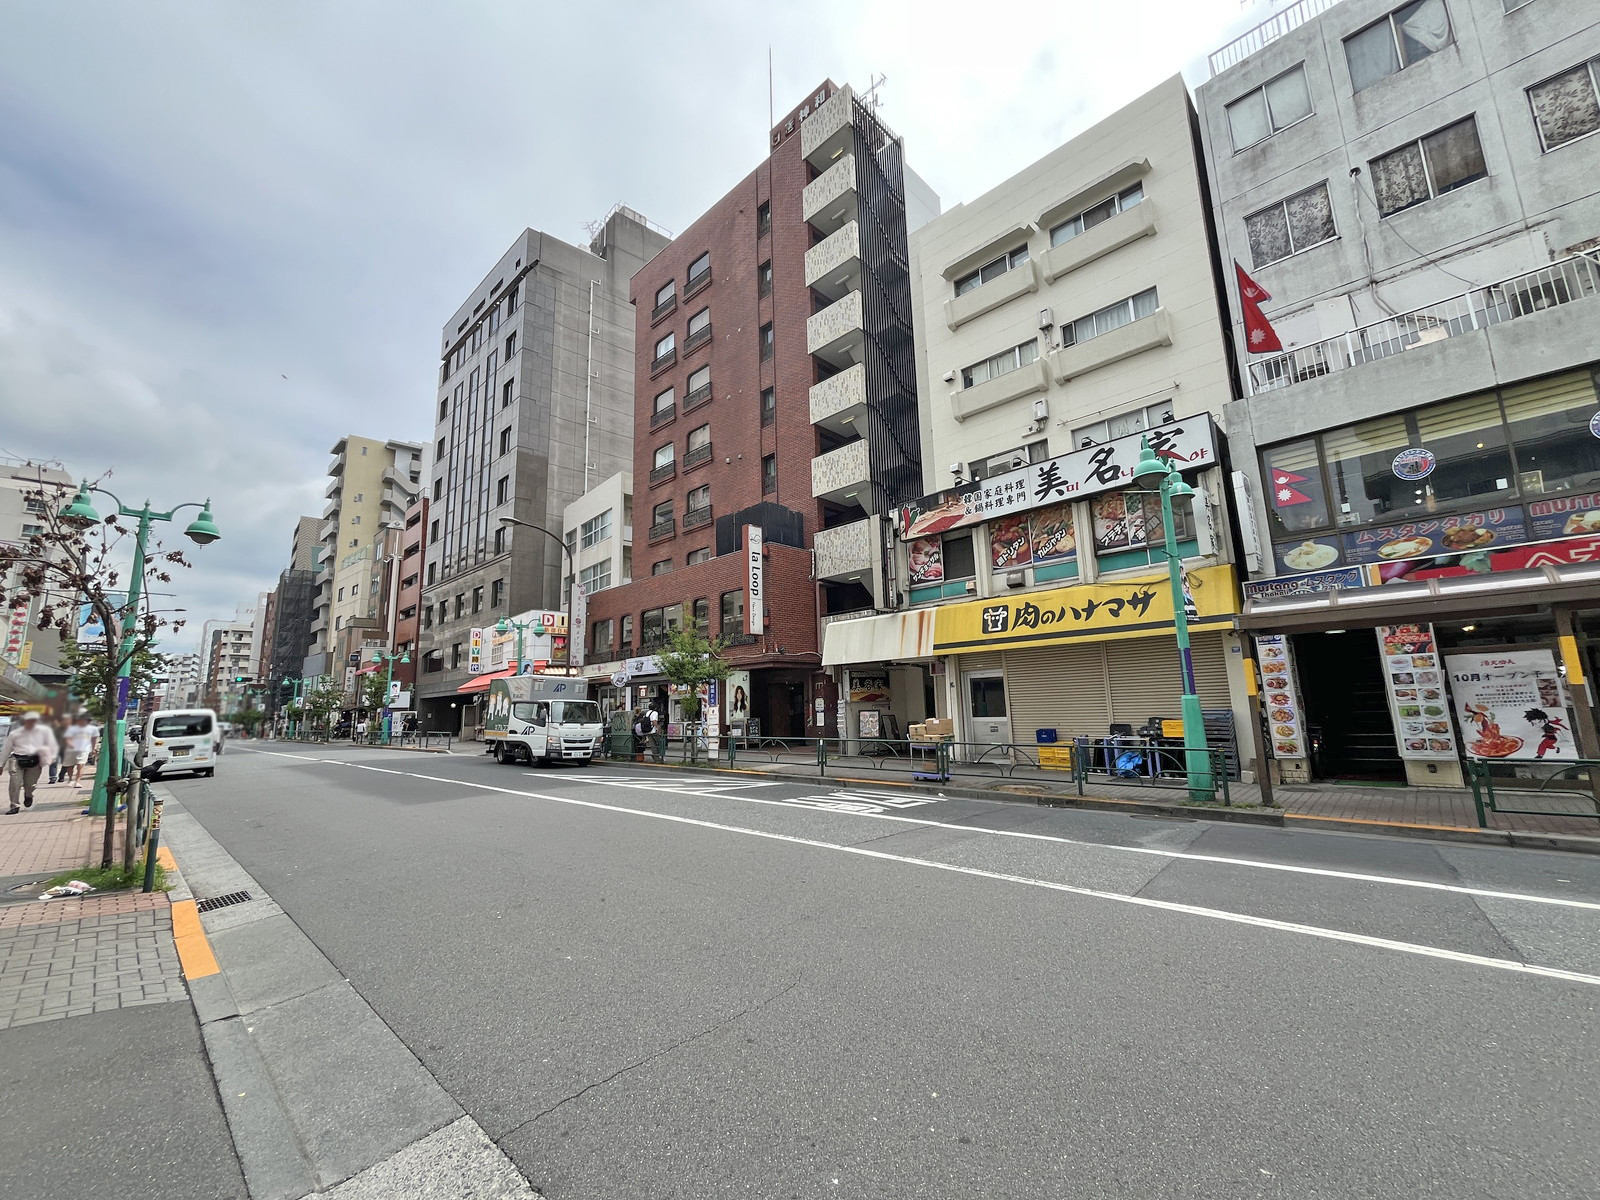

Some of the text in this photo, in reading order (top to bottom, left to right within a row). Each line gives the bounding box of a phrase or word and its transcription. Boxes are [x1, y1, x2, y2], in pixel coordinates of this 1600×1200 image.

[963, 478, 1026, 504] 韓国家庭料理
[1038, 528, 1067, 559] カムジャタン
[750, 566, 761, 596] Loop
[1247, 582, 1299, 594] Mustang
[1305, 569, 1359, 587] ムスタング
[1011, 591, 1157, 632] 肉のハナマサ
